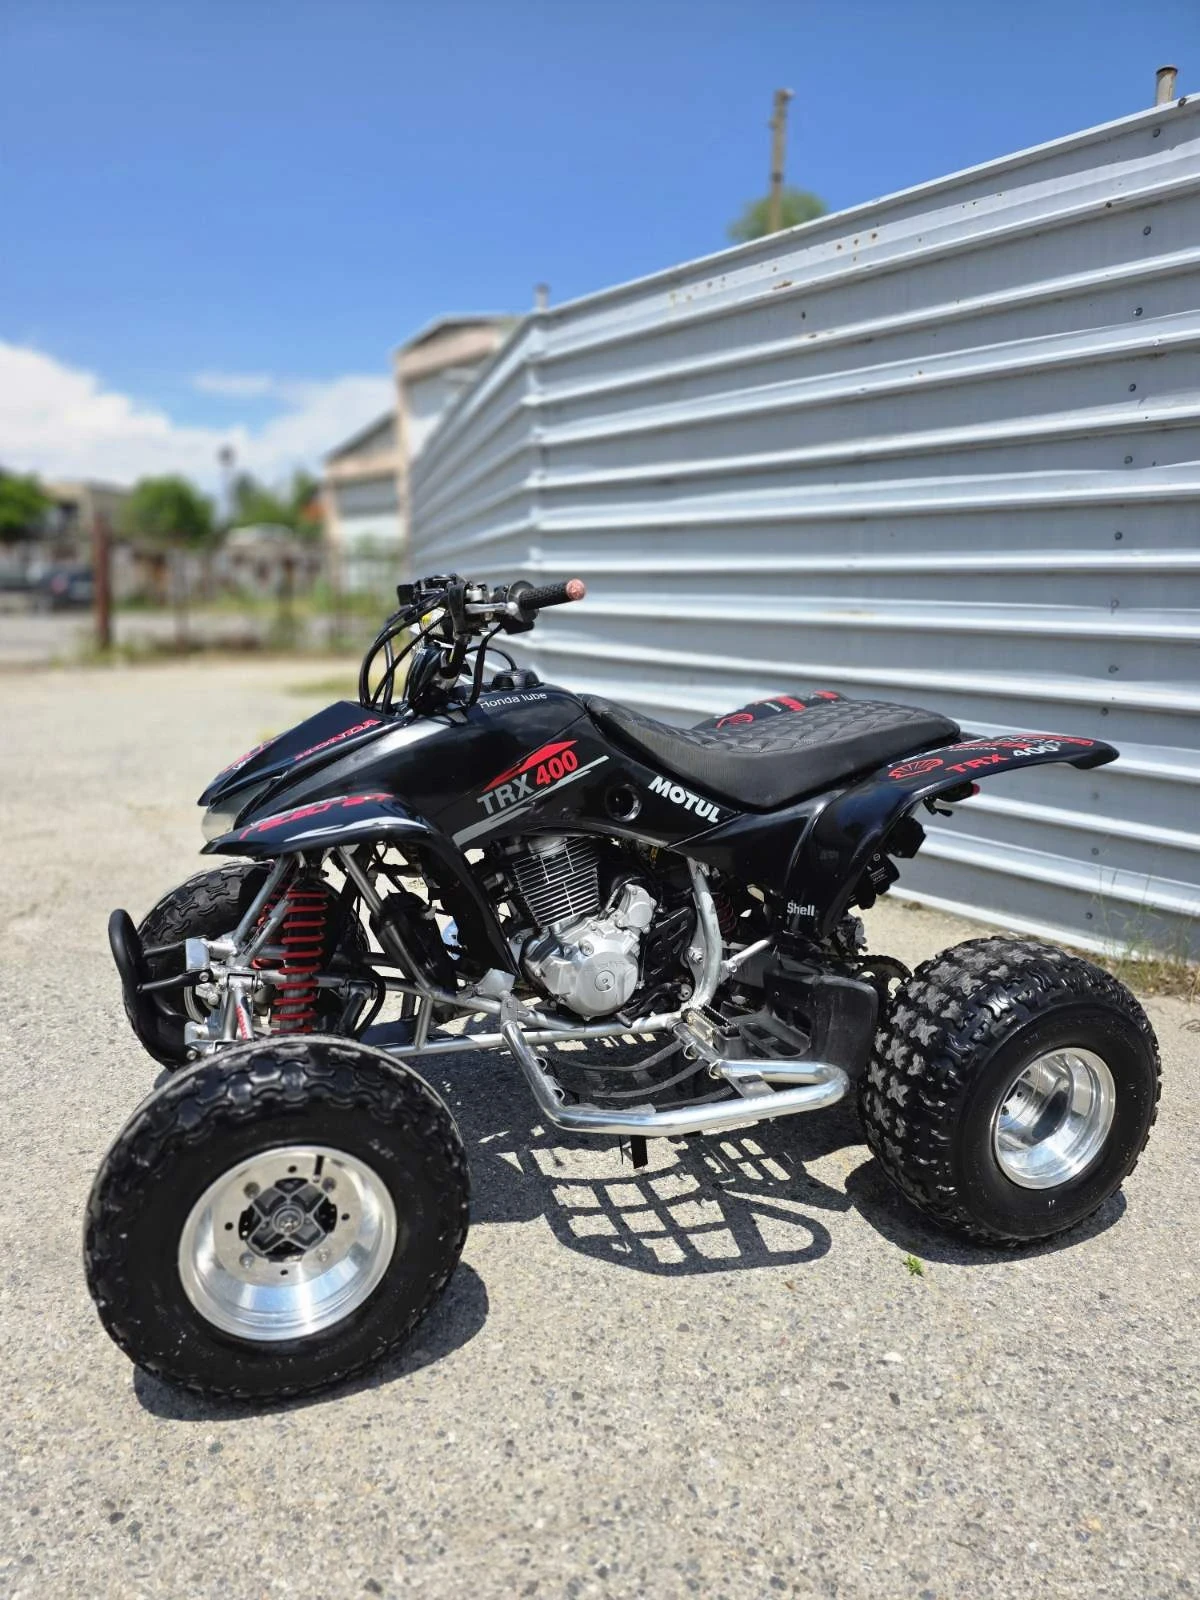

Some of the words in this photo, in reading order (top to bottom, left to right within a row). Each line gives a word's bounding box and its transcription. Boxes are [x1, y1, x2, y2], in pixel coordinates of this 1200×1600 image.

[480, 696, 521, 709] Honda
[520, 692, 548, 701] lube
[294, 719, 383, 761] HONDA
[944, 753, 1010, 773] TRX
[476, 774, 536, 815] TRX
[535, 750, 578, 785] 400
[647, 775, 720, 824] MOTUL
[786, 899, 816, 917] Shell
